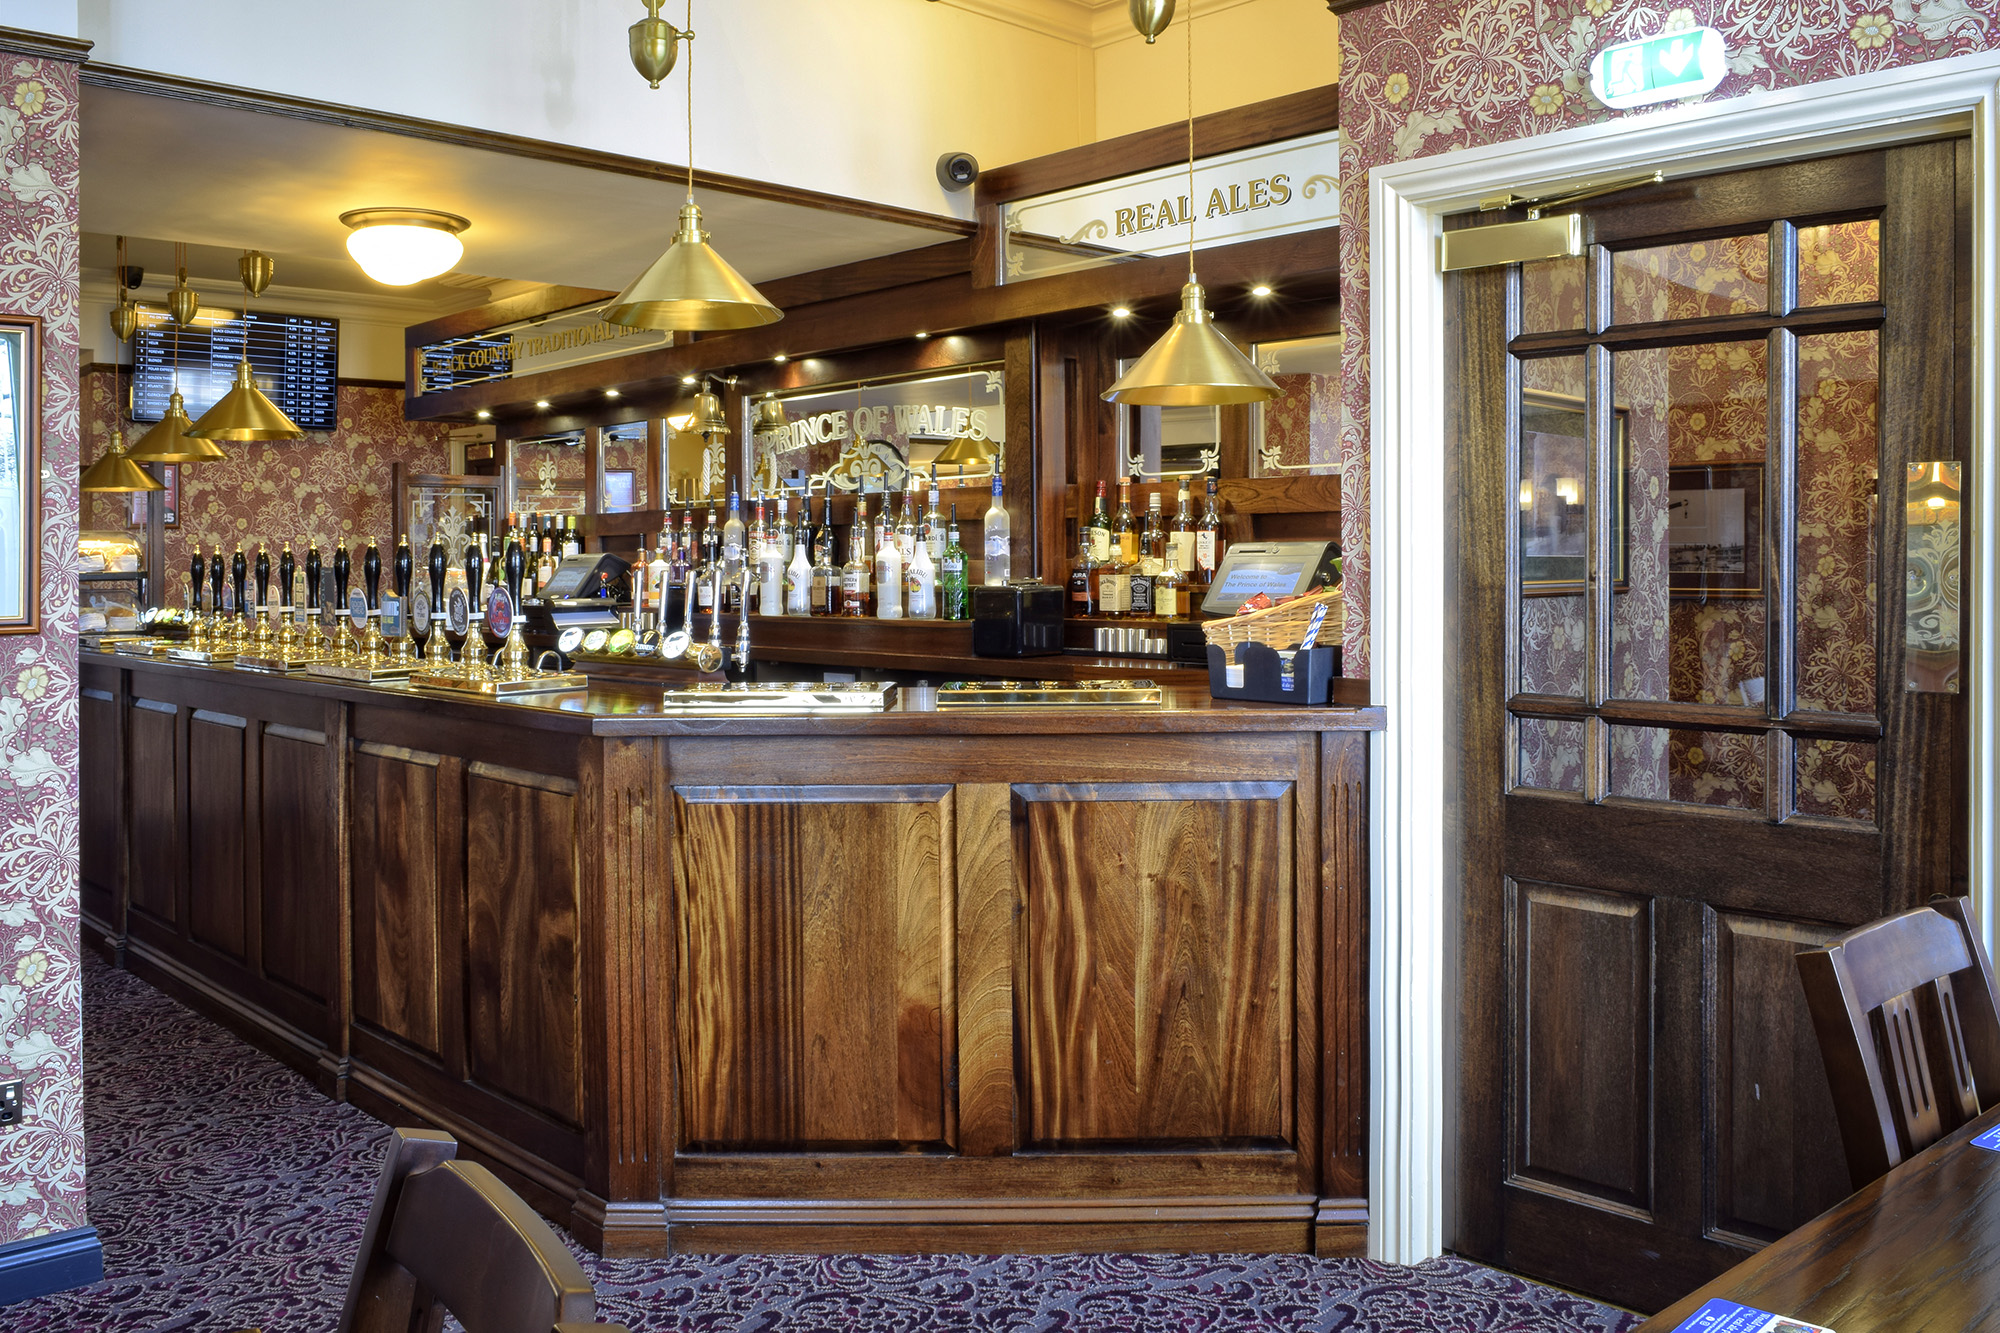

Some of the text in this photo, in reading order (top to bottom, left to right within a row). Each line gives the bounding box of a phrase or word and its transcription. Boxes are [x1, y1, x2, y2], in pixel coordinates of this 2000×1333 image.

[1115, 174, 1292, 237] REAL ALES
[432, 353, 466, 377] BLACK
[468, 341, 524, 368] COUNTRY
[526, 322, 615, 357] TRADITIONAL
[763, 404, 988, 456] PRINCE OF WALES
